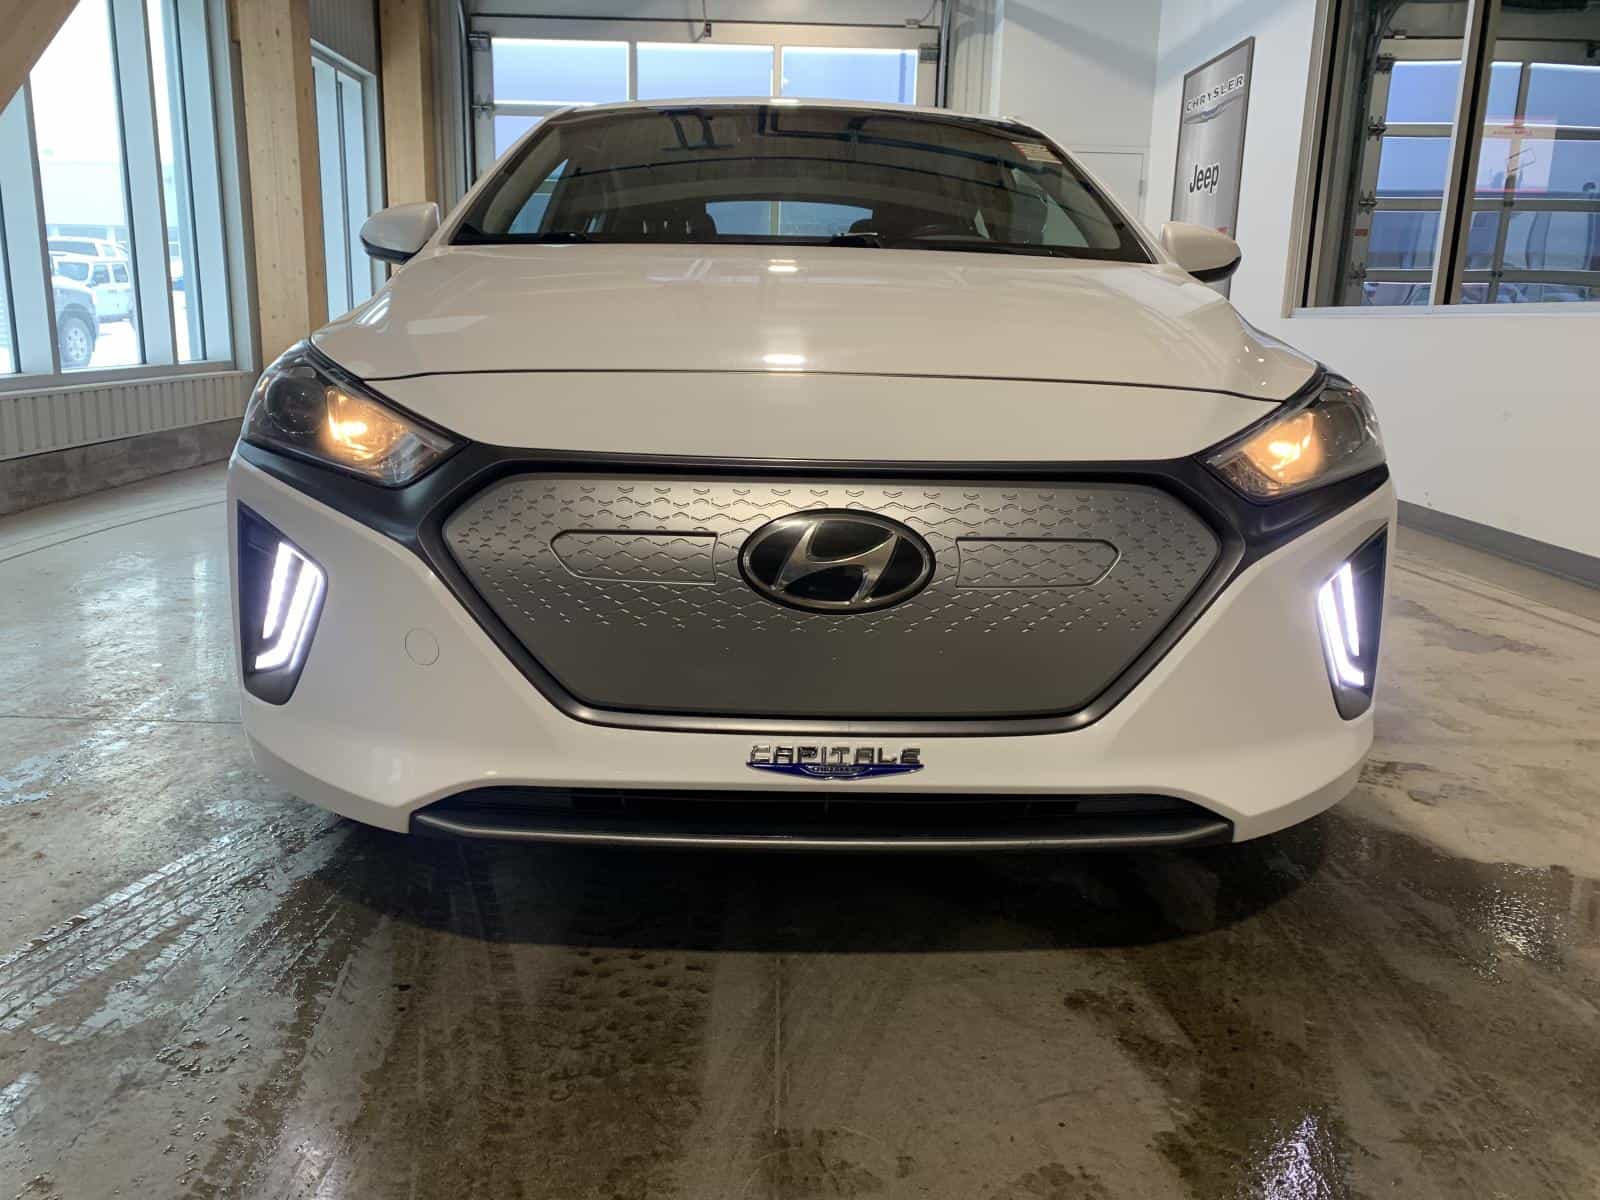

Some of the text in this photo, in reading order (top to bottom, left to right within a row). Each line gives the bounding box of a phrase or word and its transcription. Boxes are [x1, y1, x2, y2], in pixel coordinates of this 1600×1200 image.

[1186, 74, 1244, 112] CHRYSLER
[1189, 164, 1219, 193] Jeep
[750, 745, 921, 764] CAPITALE
